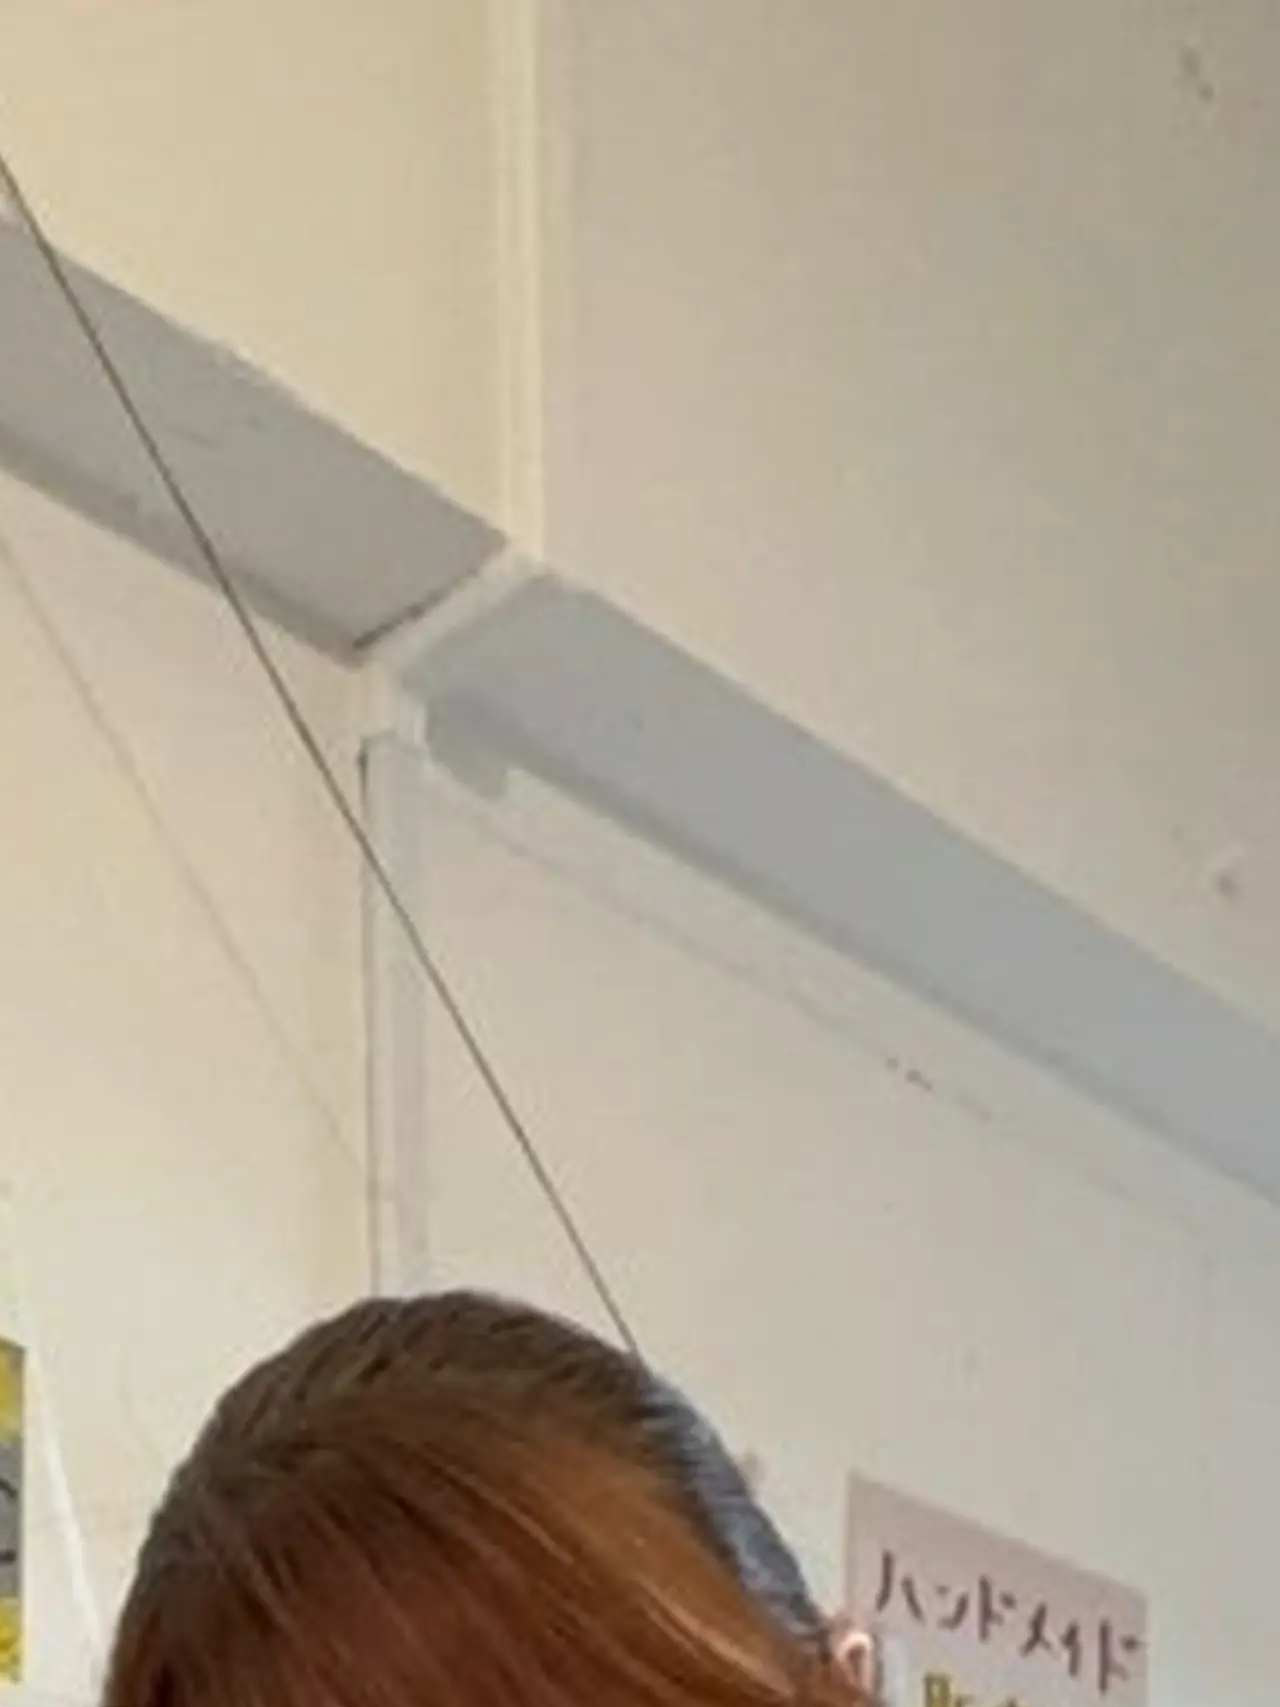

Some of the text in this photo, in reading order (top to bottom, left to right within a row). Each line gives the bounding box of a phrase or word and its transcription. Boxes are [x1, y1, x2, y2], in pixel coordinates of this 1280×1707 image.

[875, 1548, 1146, 1696] ハンドメイド
